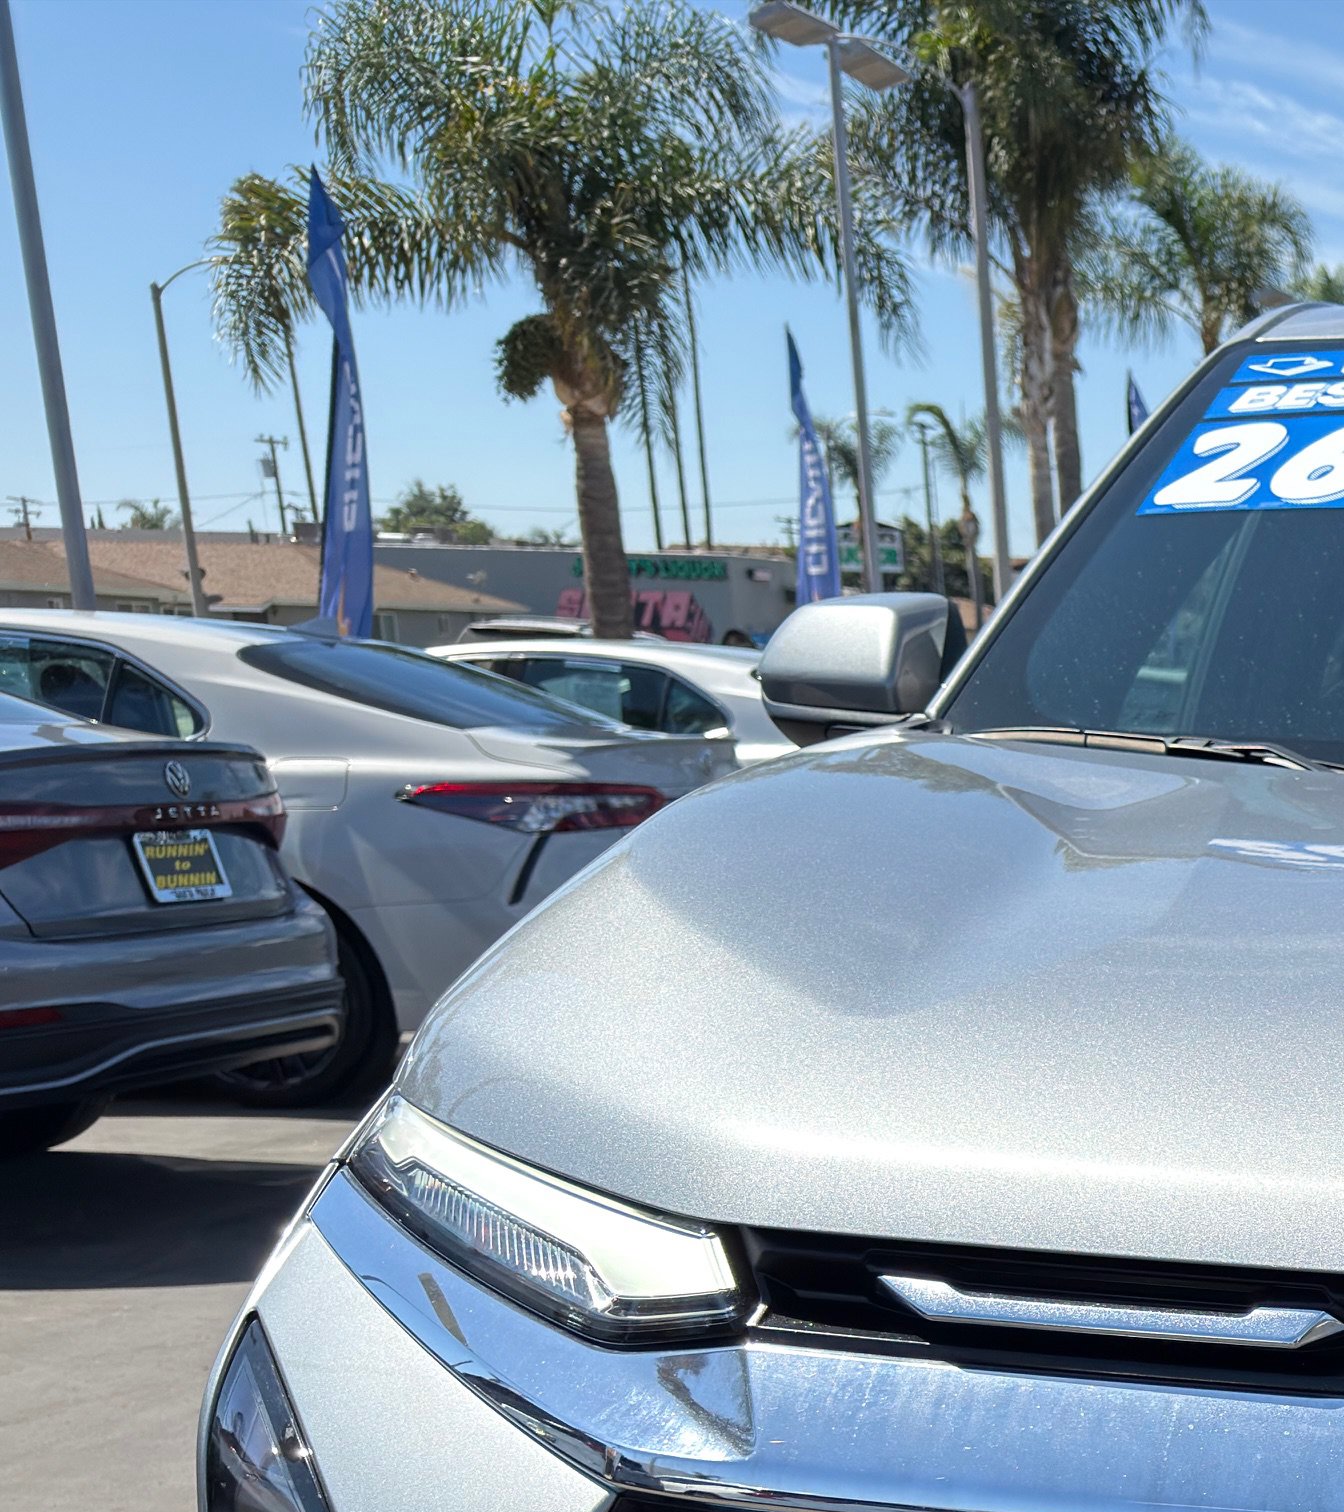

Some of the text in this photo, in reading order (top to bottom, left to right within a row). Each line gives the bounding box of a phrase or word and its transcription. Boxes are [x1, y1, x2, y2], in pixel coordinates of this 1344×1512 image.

[154, 804, 221, 820] JETTA
[145, 841, 209, 859] RUNNIN'
[174, 859, 192, 871] to
[156, 871, 217, 890] BUNNIN
